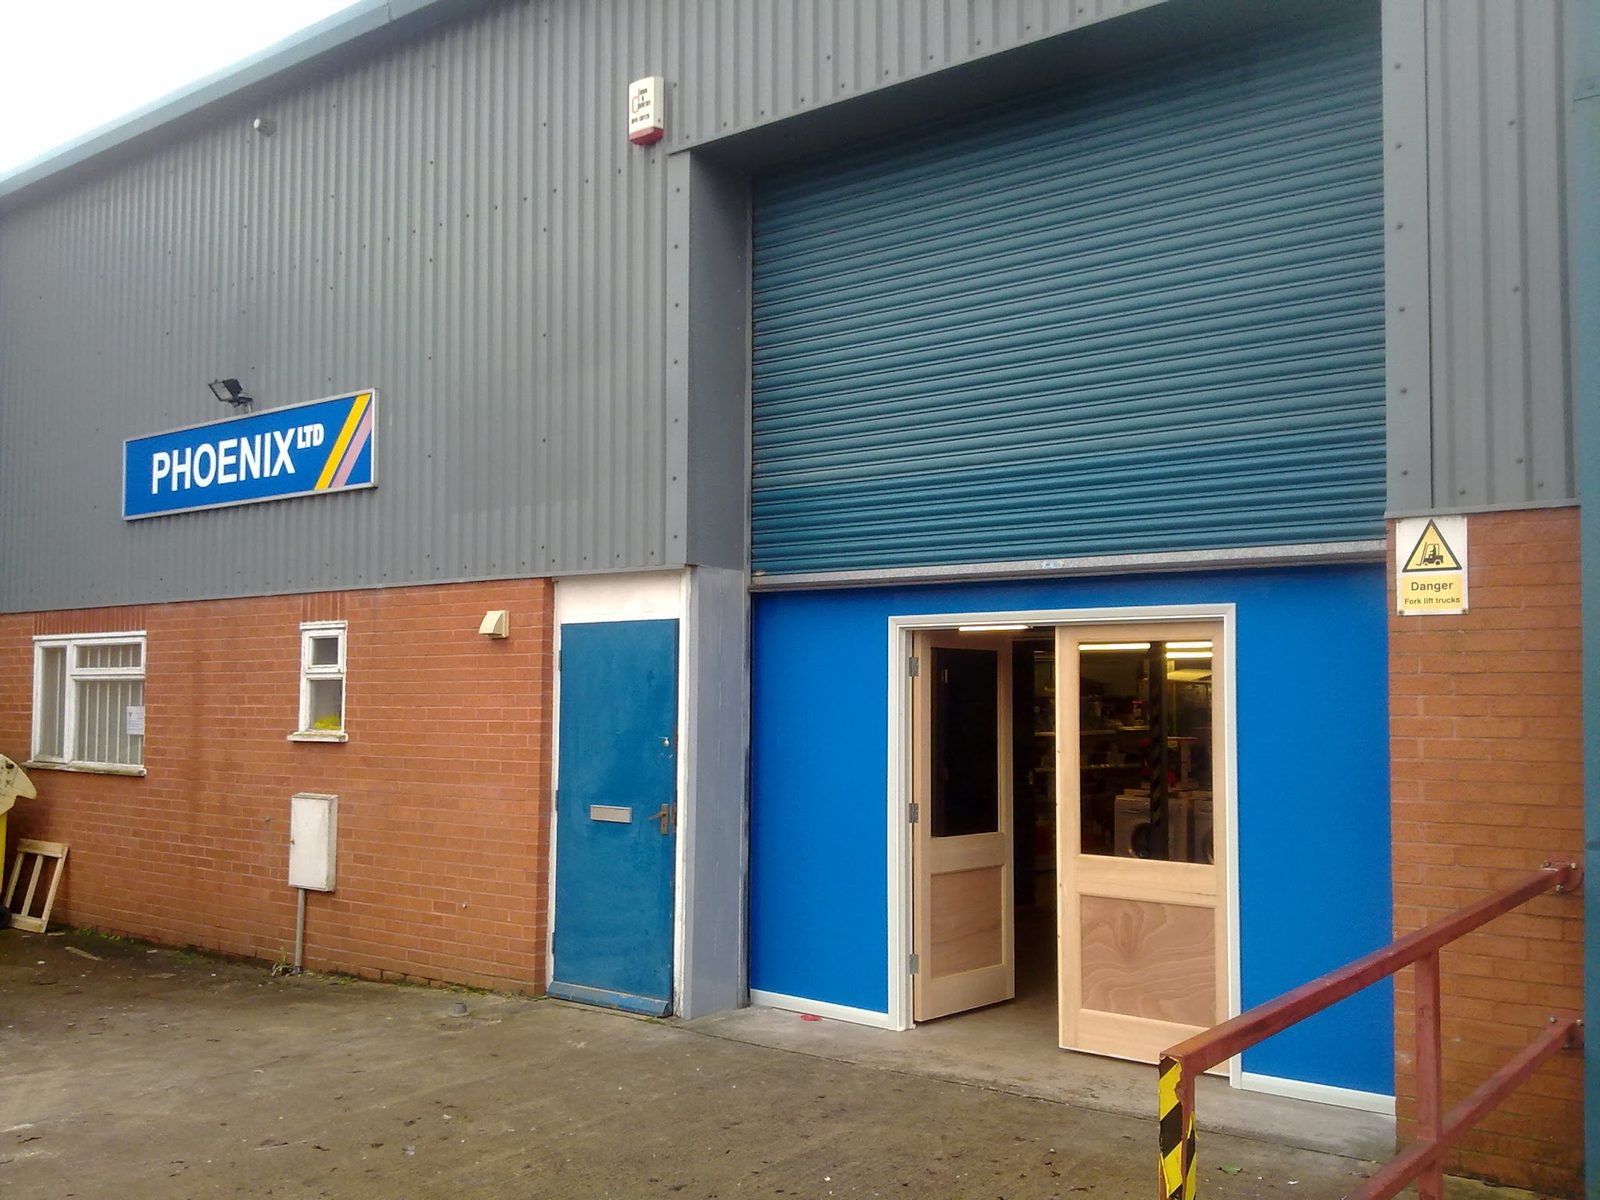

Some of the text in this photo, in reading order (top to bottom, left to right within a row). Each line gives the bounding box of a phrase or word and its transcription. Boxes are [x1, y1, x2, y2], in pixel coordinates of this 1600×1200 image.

[152, 423, 325, 494] PHOENIX LTD
[1411, 582, 1453, 592] Danger
[1435, 596, 1461, 604] trucks
